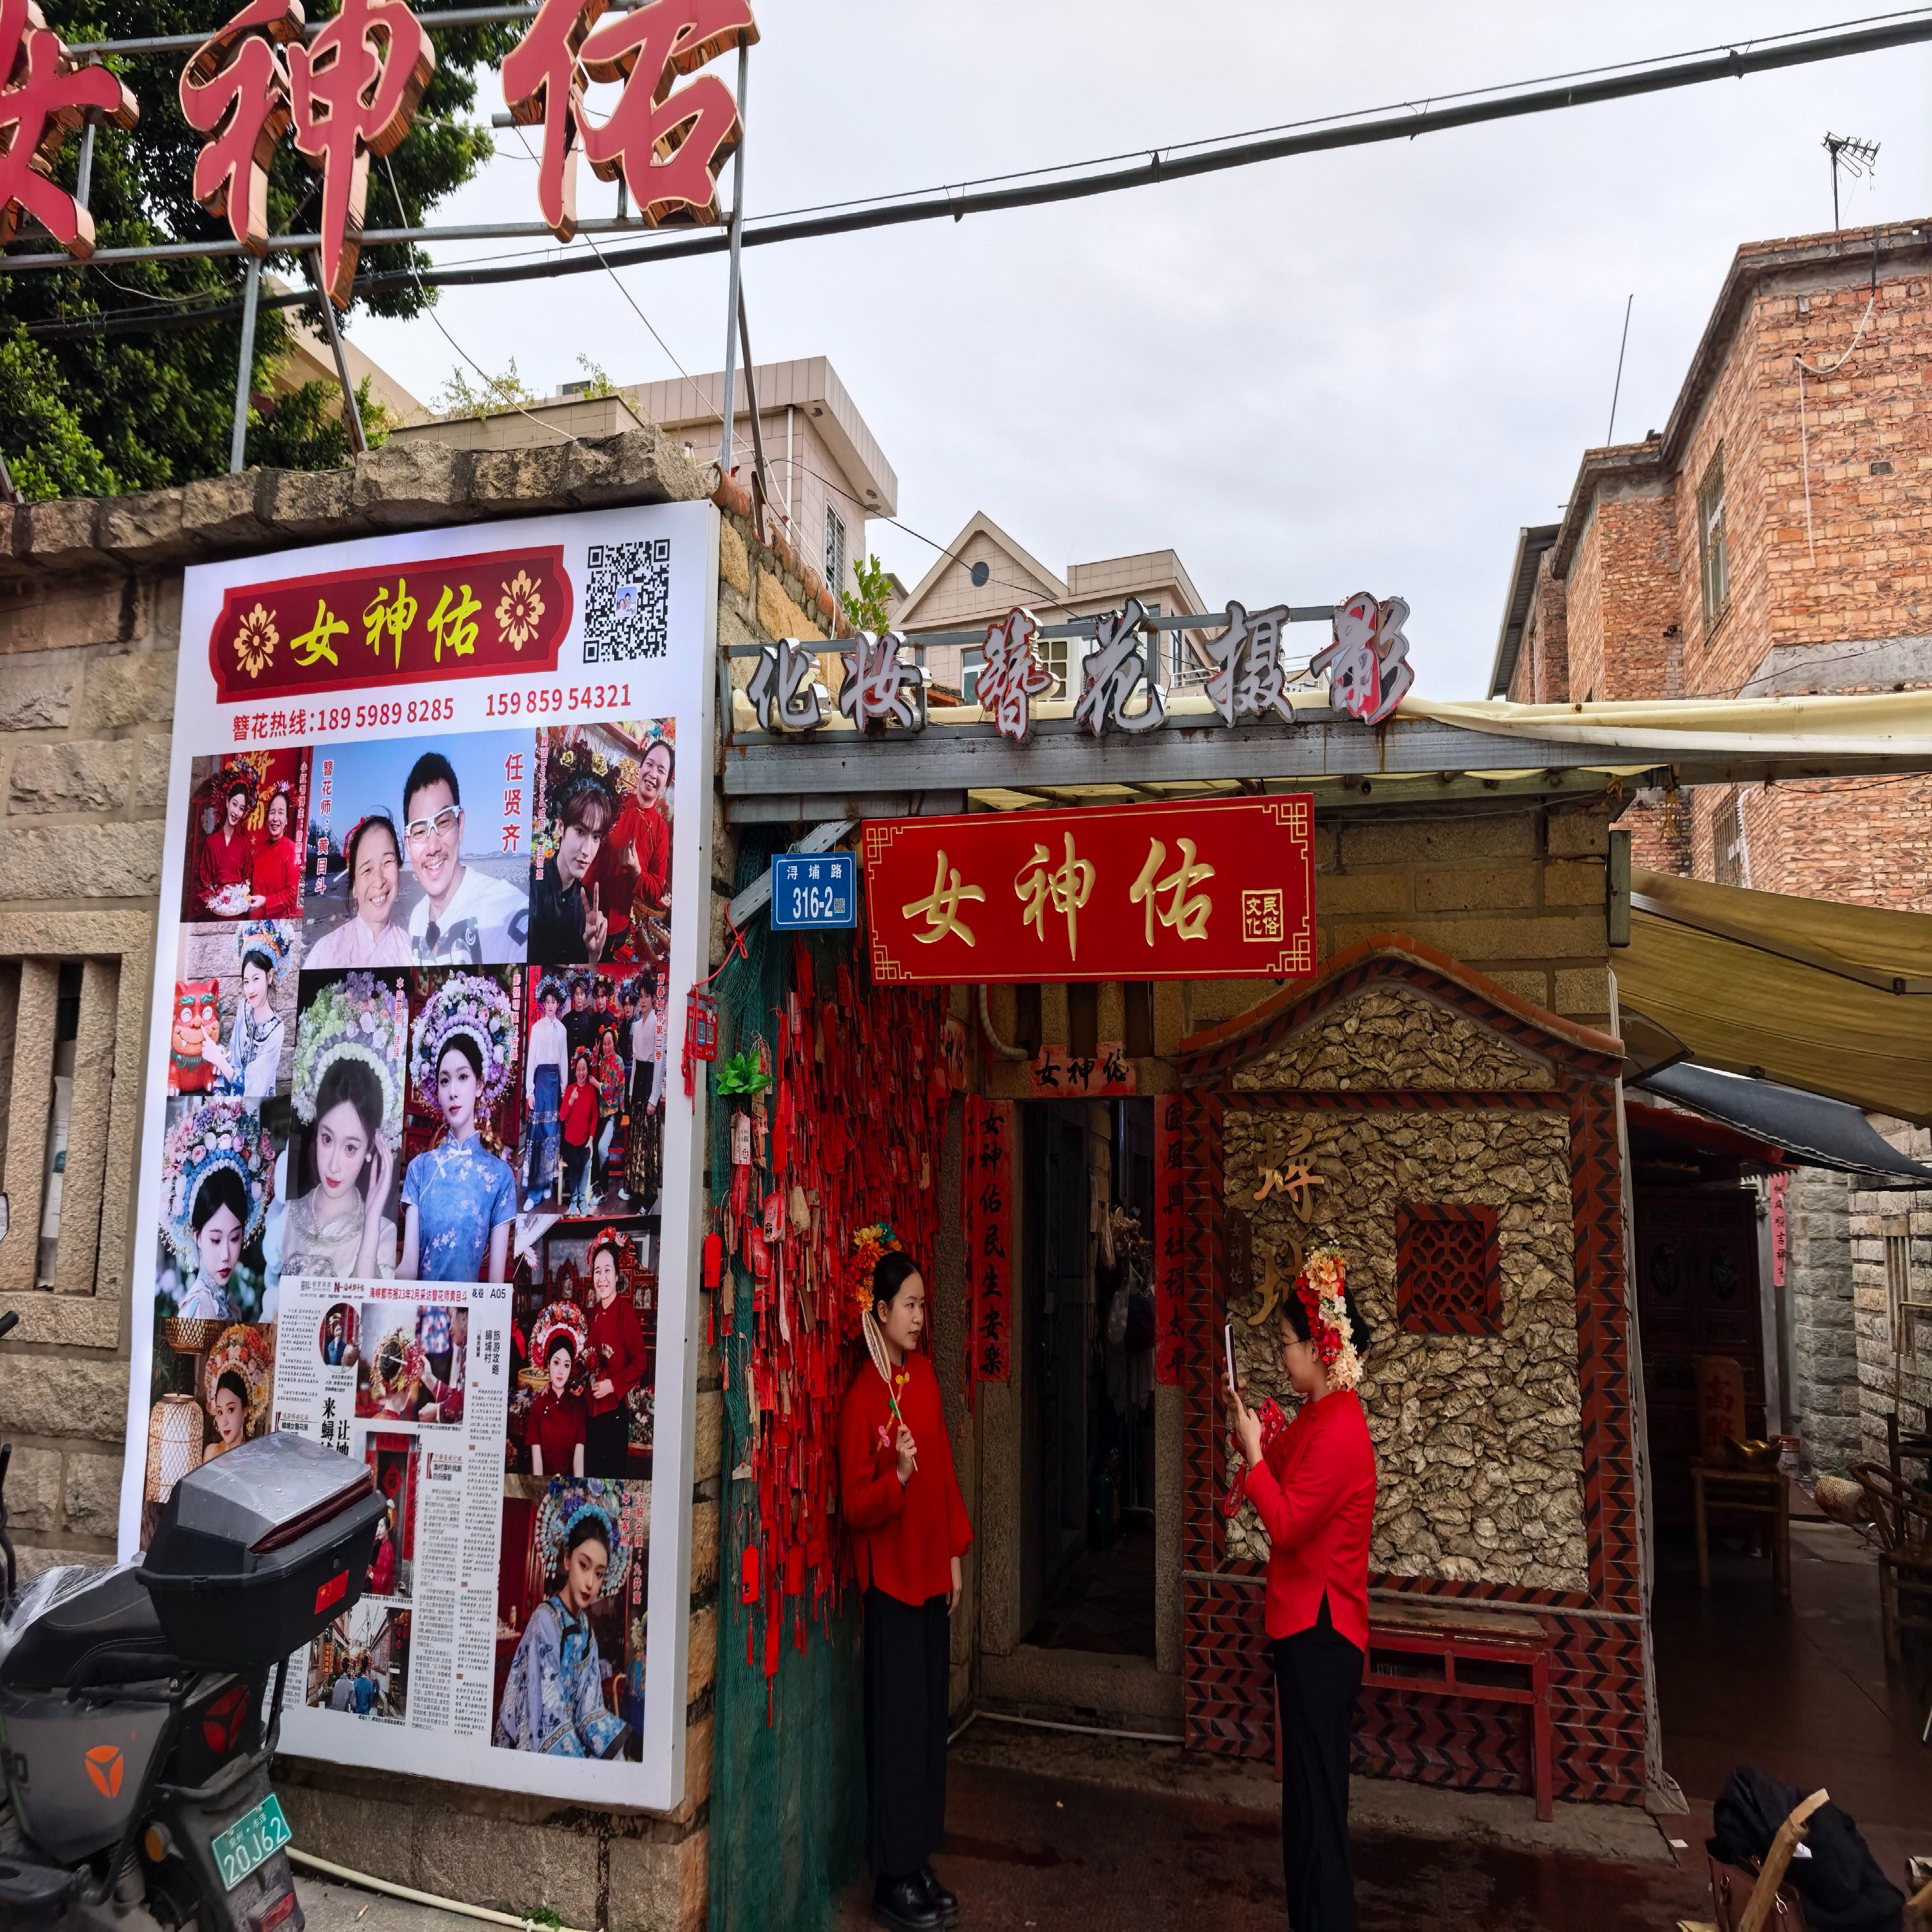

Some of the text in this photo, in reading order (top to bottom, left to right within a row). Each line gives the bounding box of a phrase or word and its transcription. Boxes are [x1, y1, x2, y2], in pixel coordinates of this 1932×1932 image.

[290, 577, 483, 669] 女神佑
[746, 591, 1415, 743] 化妆簪花摄影
[501, 752, 525, 853] 任贤齐
[787, 863, 842, 880] 浔埔路
[793, 886, 833, 919] 316-2
[902, 831, 1216, 961] 女神佑
[654, 973, 665, 1062] 青春有你第二季
[1034, 1048, 1129, 1092] 女神佑
[490, 1288, 506, 1299] A05
[321, 1397, 336, 1447] 来蟳
[224, 1816, 287, 1883] 20J62
